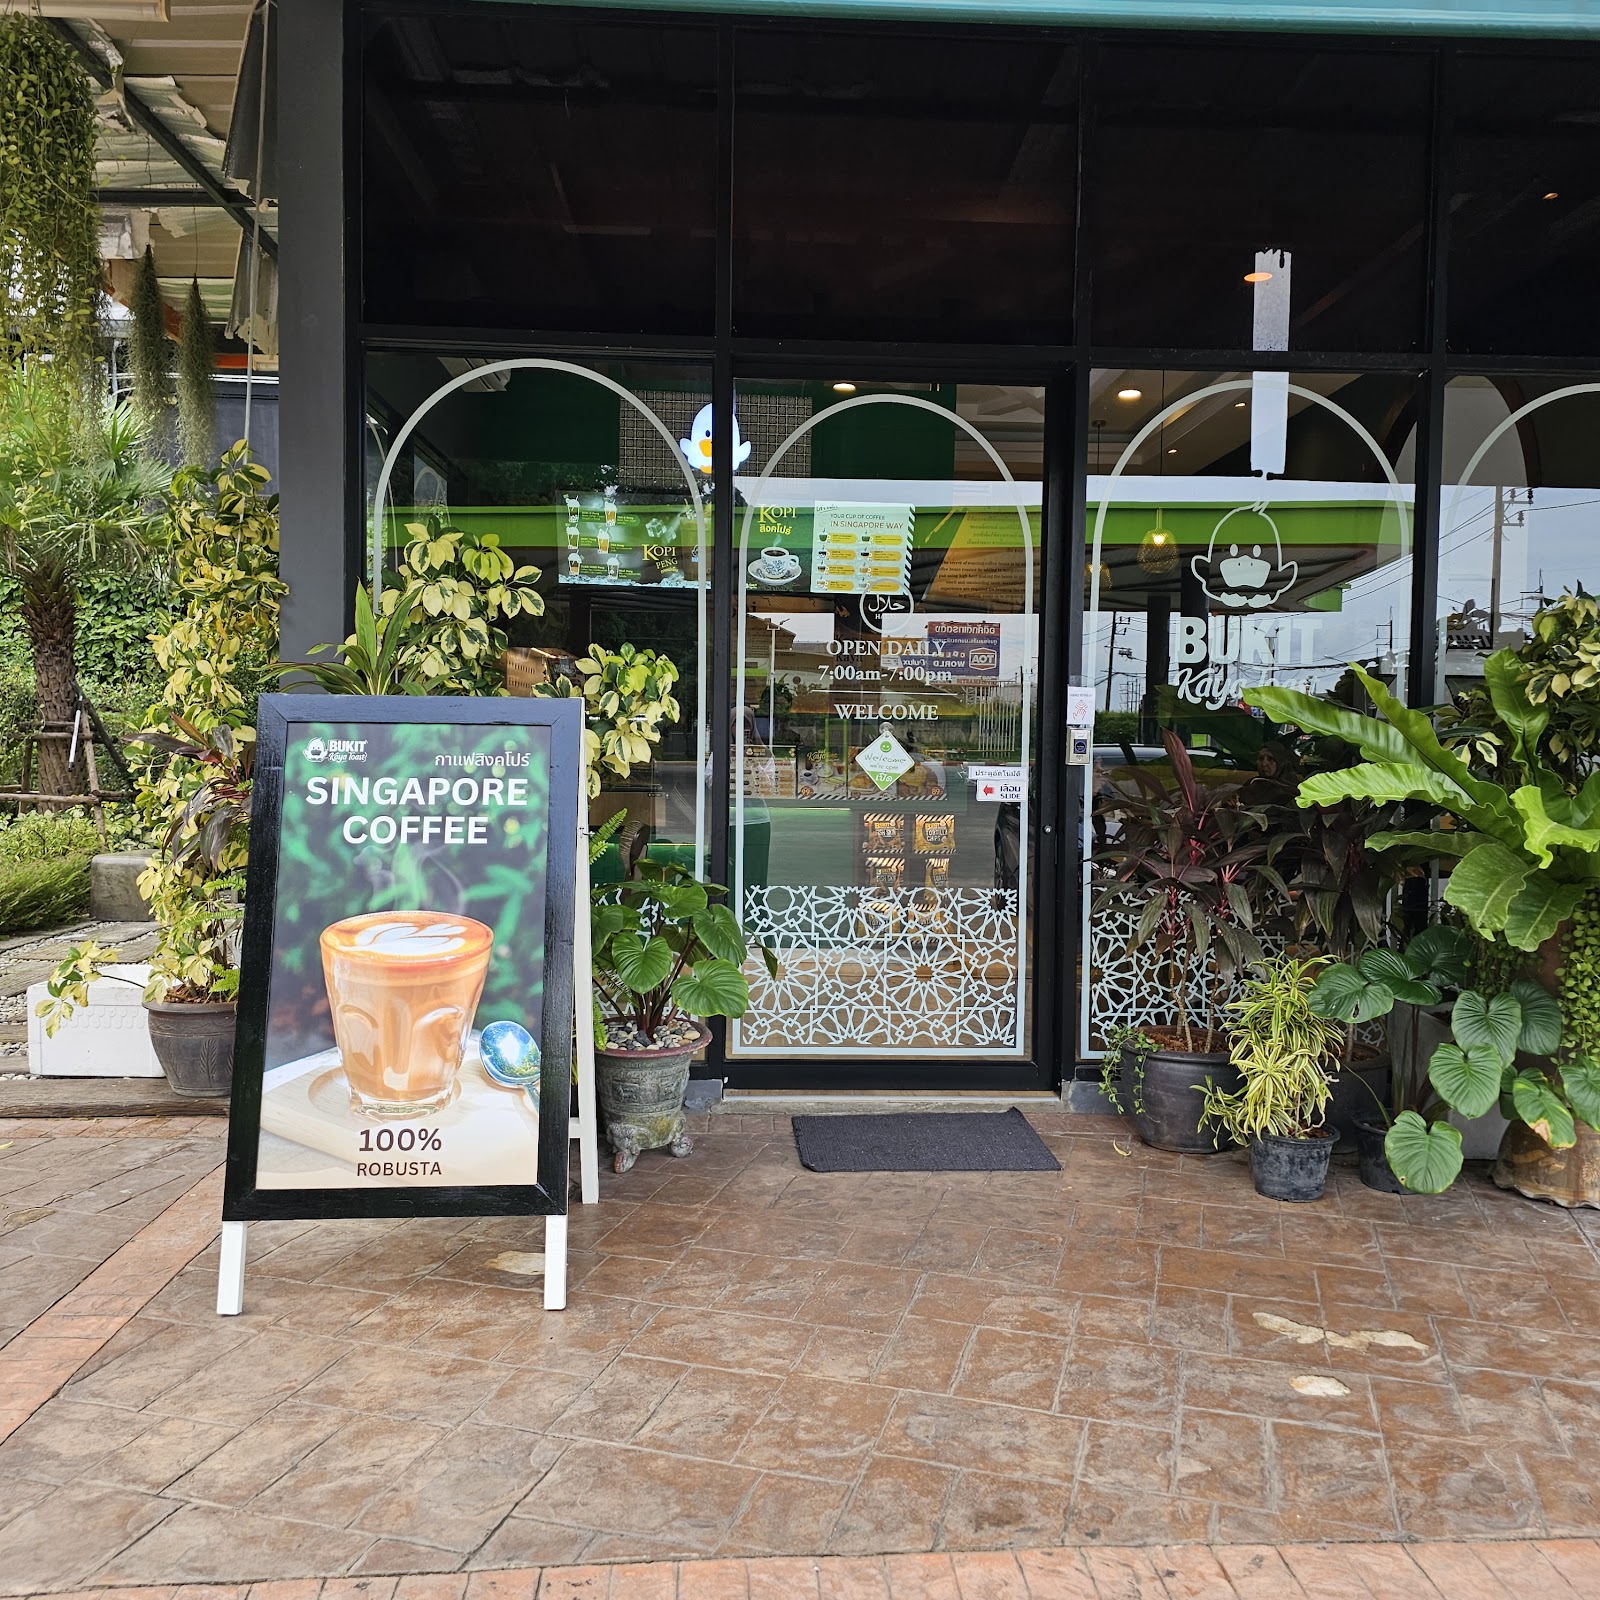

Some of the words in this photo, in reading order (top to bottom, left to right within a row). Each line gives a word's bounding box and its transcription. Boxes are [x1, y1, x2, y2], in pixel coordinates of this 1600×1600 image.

[758, 504, 796, 524] KOPI
[759, 523, 792, 535] สิงคโปร์
[642, 544, 676, 560] KOPI
[656, 557, 678, 569] PENG
[868, 593, 905, 612] حلال
[826, 640, 881, 656] OPEN
[886, 640, 947, 656] DAILY
[1179, 616, 1322, 665] BUKIT
[818, 665, 952, 685] 7:00am-7:00pm
[1175, 668, 1243, 711] Kaya
[834, 704, 938, 720] WELCOME
[329, 740, 366, 752] BUKIT
[328, 752, 347, 763] Kaya
[348, 752, 366, 761] Toast
[435, 751, 530, 767] กาแฟสิงคโปร์
[864, 753, 907, 763] Welcome
[875, 772, 892, 783] เปิด
[305, 776, 528, 806] SINGAPORE
[1000, 782, 1020, 792] เลื่อน
[342, 816, 488, 845] COFFEE
[359, 1128, 442, 1152] 100%
[356, 1162, 442, 1177] ROBUSTA
